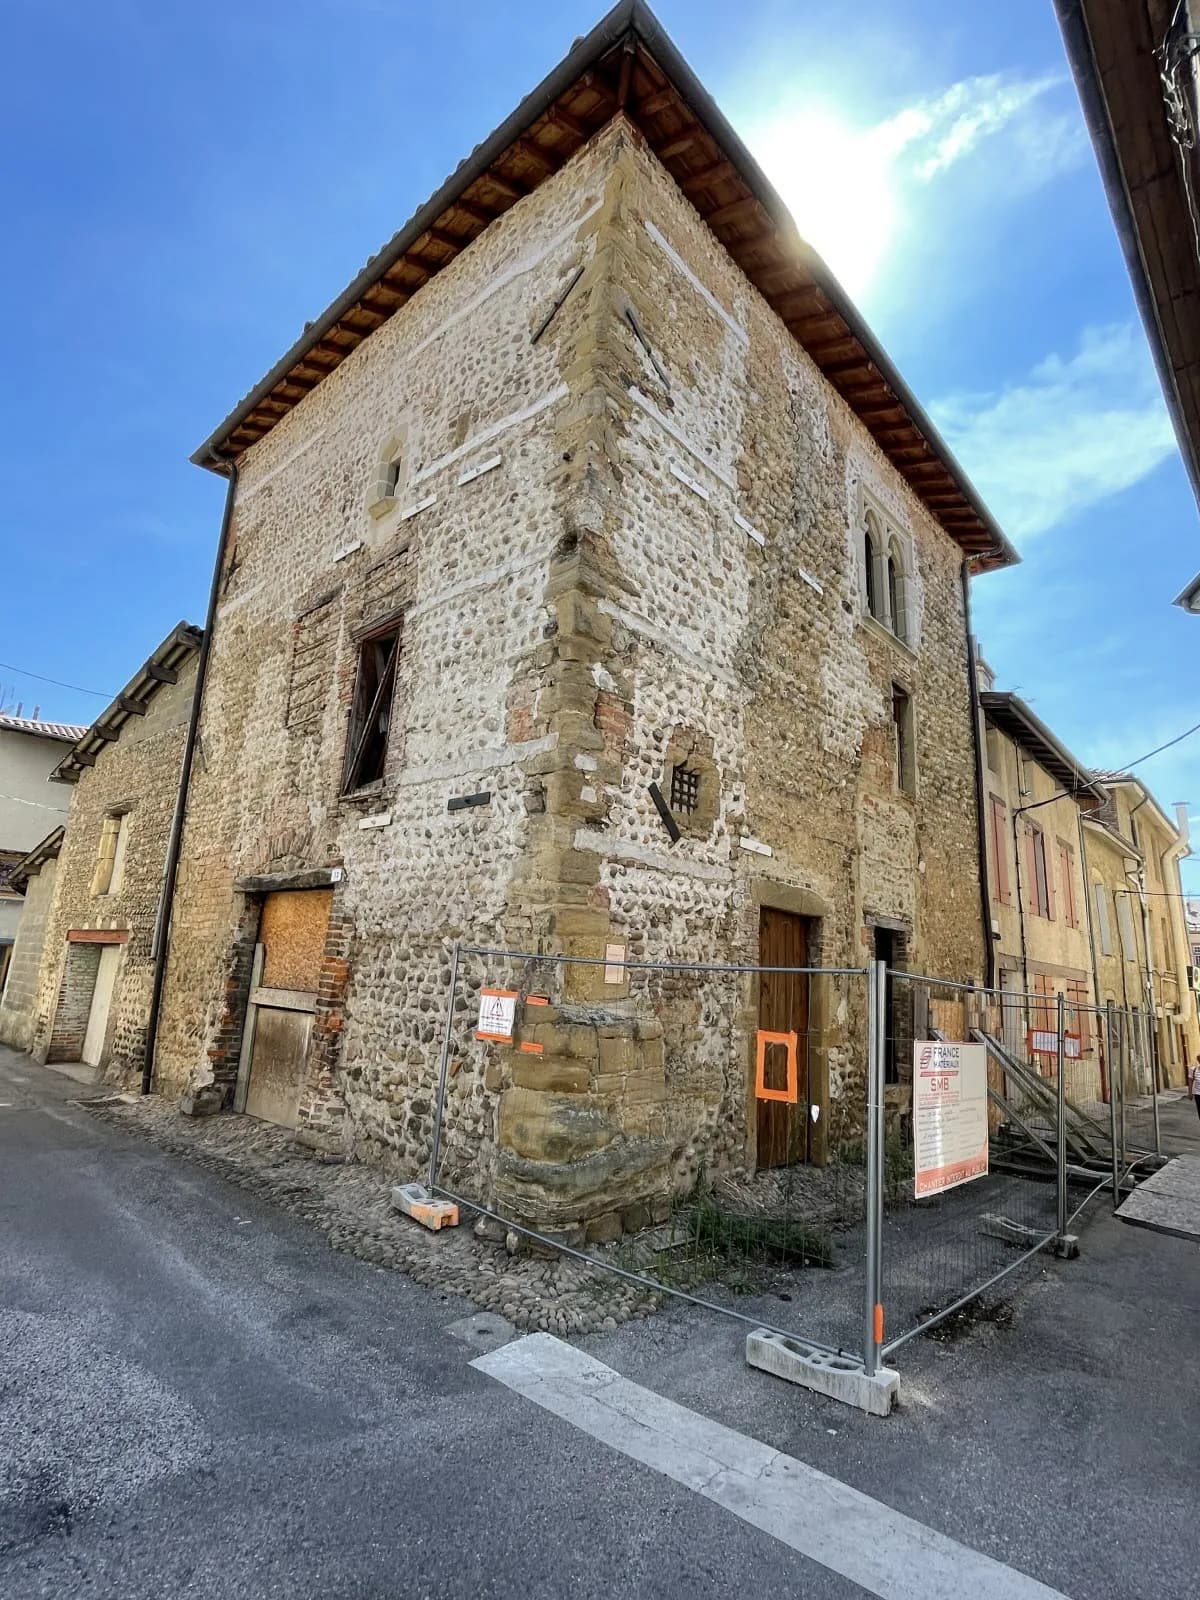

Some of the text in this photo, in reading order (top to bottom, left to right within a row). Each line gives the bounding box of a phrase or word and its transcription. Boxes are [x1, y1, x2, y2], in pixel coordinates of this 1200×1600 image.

[933, 1047, 959, 1058] FRANCE
[931, 1077, 949, 1091] SMB
[920, 1176, 945, 1192] CHANTIER
